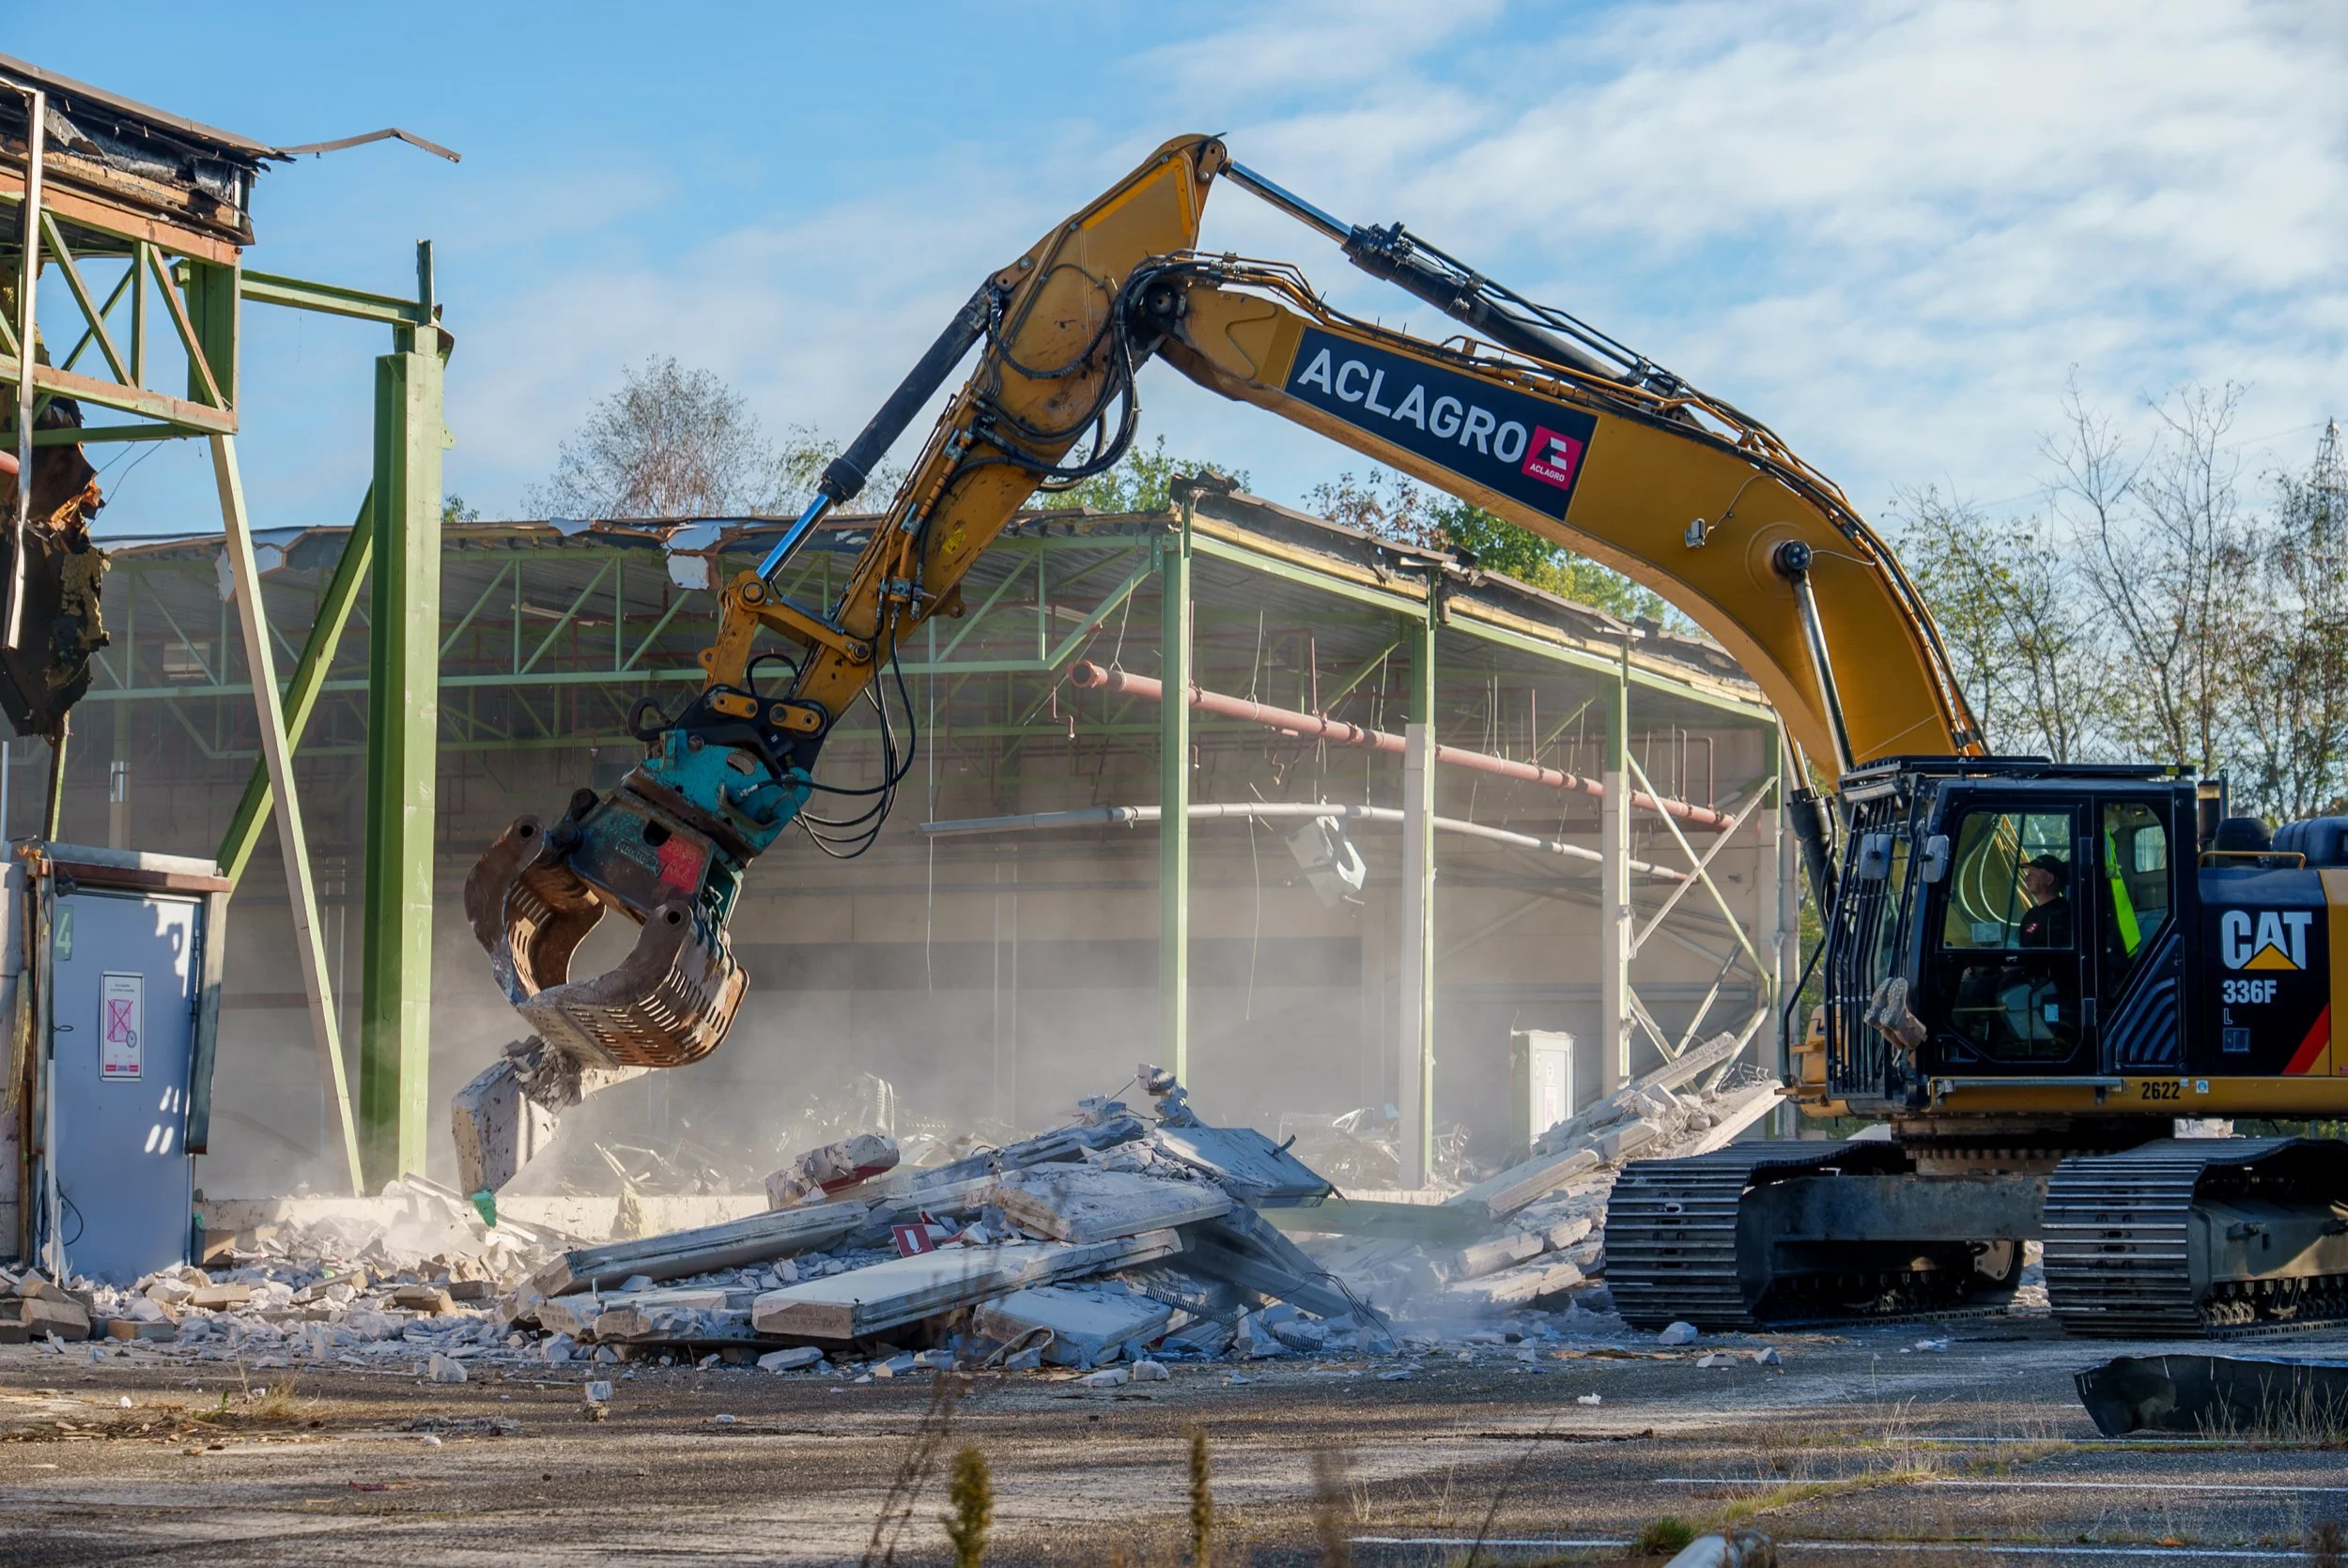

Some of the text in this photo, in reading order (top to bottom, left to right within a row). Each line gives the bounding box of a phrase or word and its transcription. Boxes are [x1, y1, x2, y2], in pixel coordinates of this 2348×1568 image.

[1297, 347, 1528, 464] ACLAGRO
[1529, 463, 1566, 483] ACLAGRO
[55, 913, 72, 954] 4
[2221, 910, 2312, 970] CAT
[2222, 980, 2277, 1004] 336F
[2141, 1082, 2181, 1100] 2622
